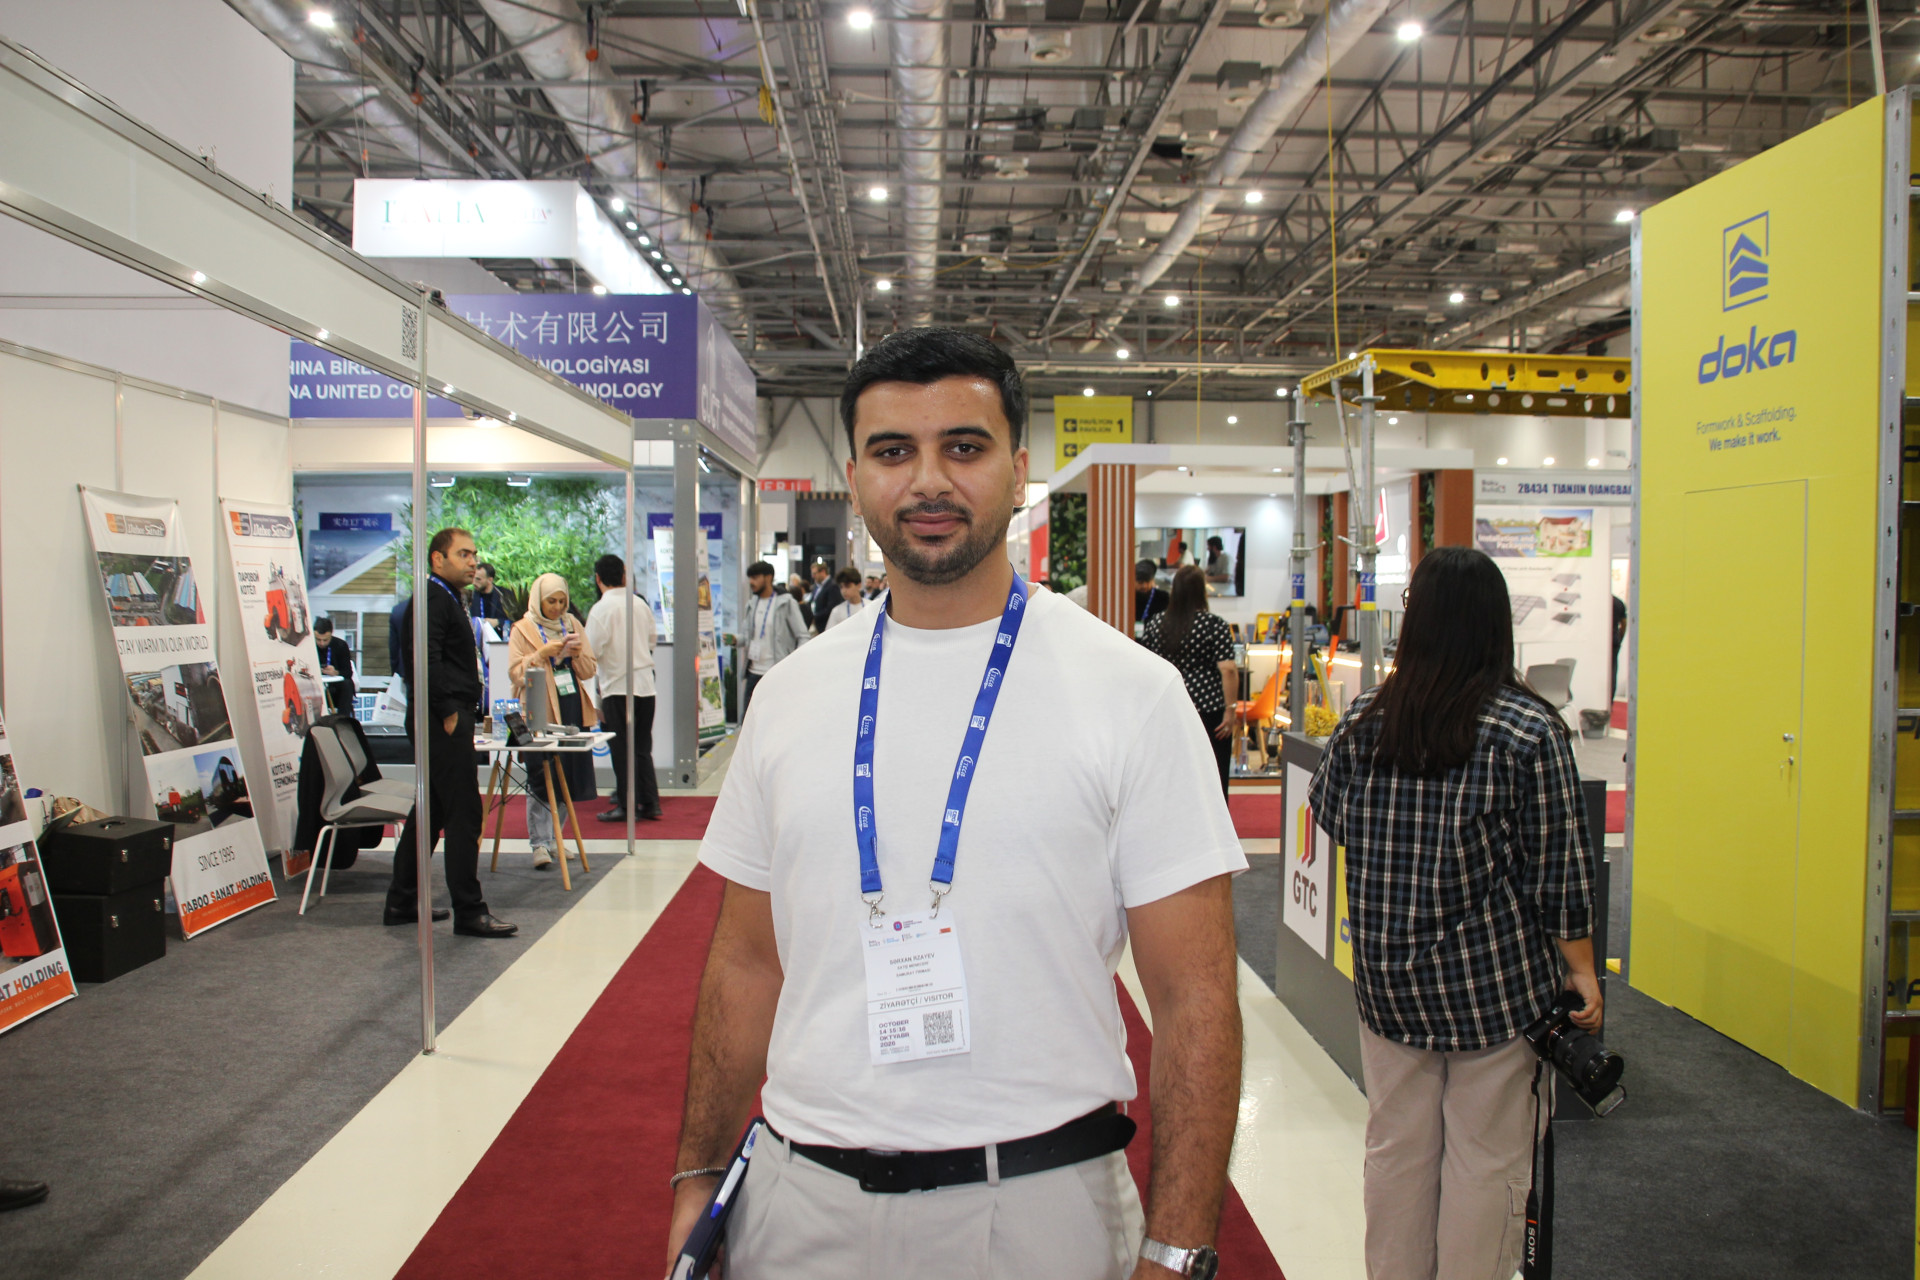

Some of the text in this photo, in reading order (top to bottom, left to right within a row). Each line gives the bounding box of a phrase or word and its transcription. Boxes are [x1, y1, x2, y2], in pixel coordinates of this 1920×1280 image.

[531, 355, 649, 374] NOLOGİYASI
[1698, 325, 1797, 385] doka
[316, 384, 382, 399] UNITED
[579, 383, 664, 398] NOLOGY
[1117, 419, 1123, 432] 1
[1697, 416, 1734, 434] Formwork
[1709, 438, 1722, 451] We
[1724, 434, 1746, 449] make
[1749, 431, 1754, 445] it
[1552, 483, 1586, 494] TIANJIN
[136, 638, 159, 653] WARM
[160, 638, 168, 652] IN
[169, 637, 184, 652] OUR
[186, 635, 208, 650] WORLD
[198, 846, 236, 871] SINCE 1995
[181, 894, 209, 915] DABOO
[210, 884, 235, 903] SANAT
[236, 872, 268, 892] HOLDING
[1294, 870, 1317, 918] GTC
[13, 961, 64, 994] HOLDING
[924, 993, 953, 1002] VISITOR
[879, 1019, 909, 1028] OCTOBER
[1527, 1226, 1535, 1267] SONY
